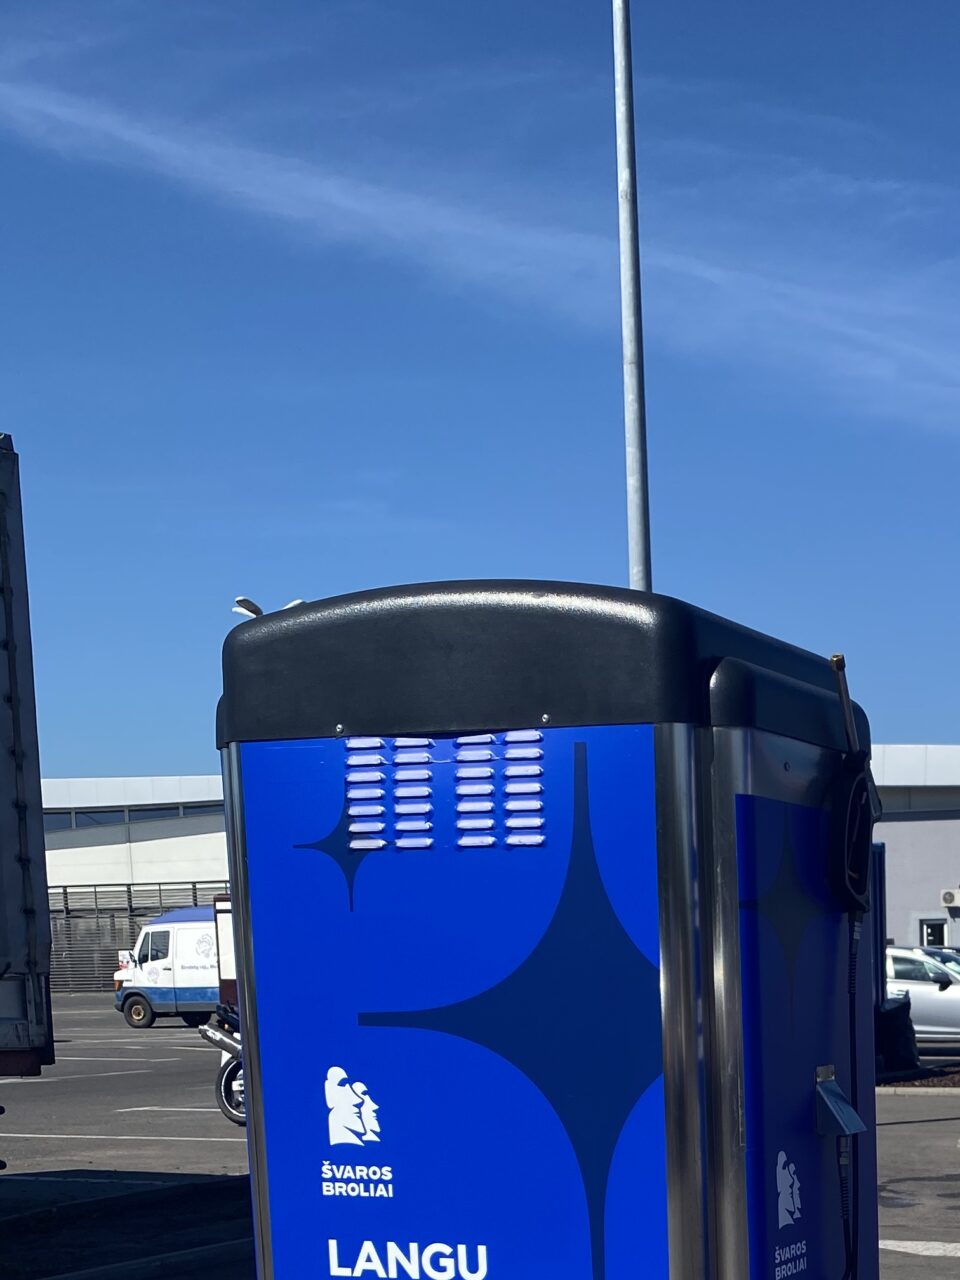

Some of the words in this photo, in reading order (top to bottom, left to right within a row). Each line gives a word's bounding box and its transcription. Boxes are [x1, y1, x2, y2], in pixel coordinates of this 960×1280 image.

[321, 1160, 393, 1181] ŠVAROS
[321, 1181, 394, 1198] BROLIAI
[774, 1240, 807, 1264] ŠVAROS
[775, 1256, 807, 1280] BROLIAI
